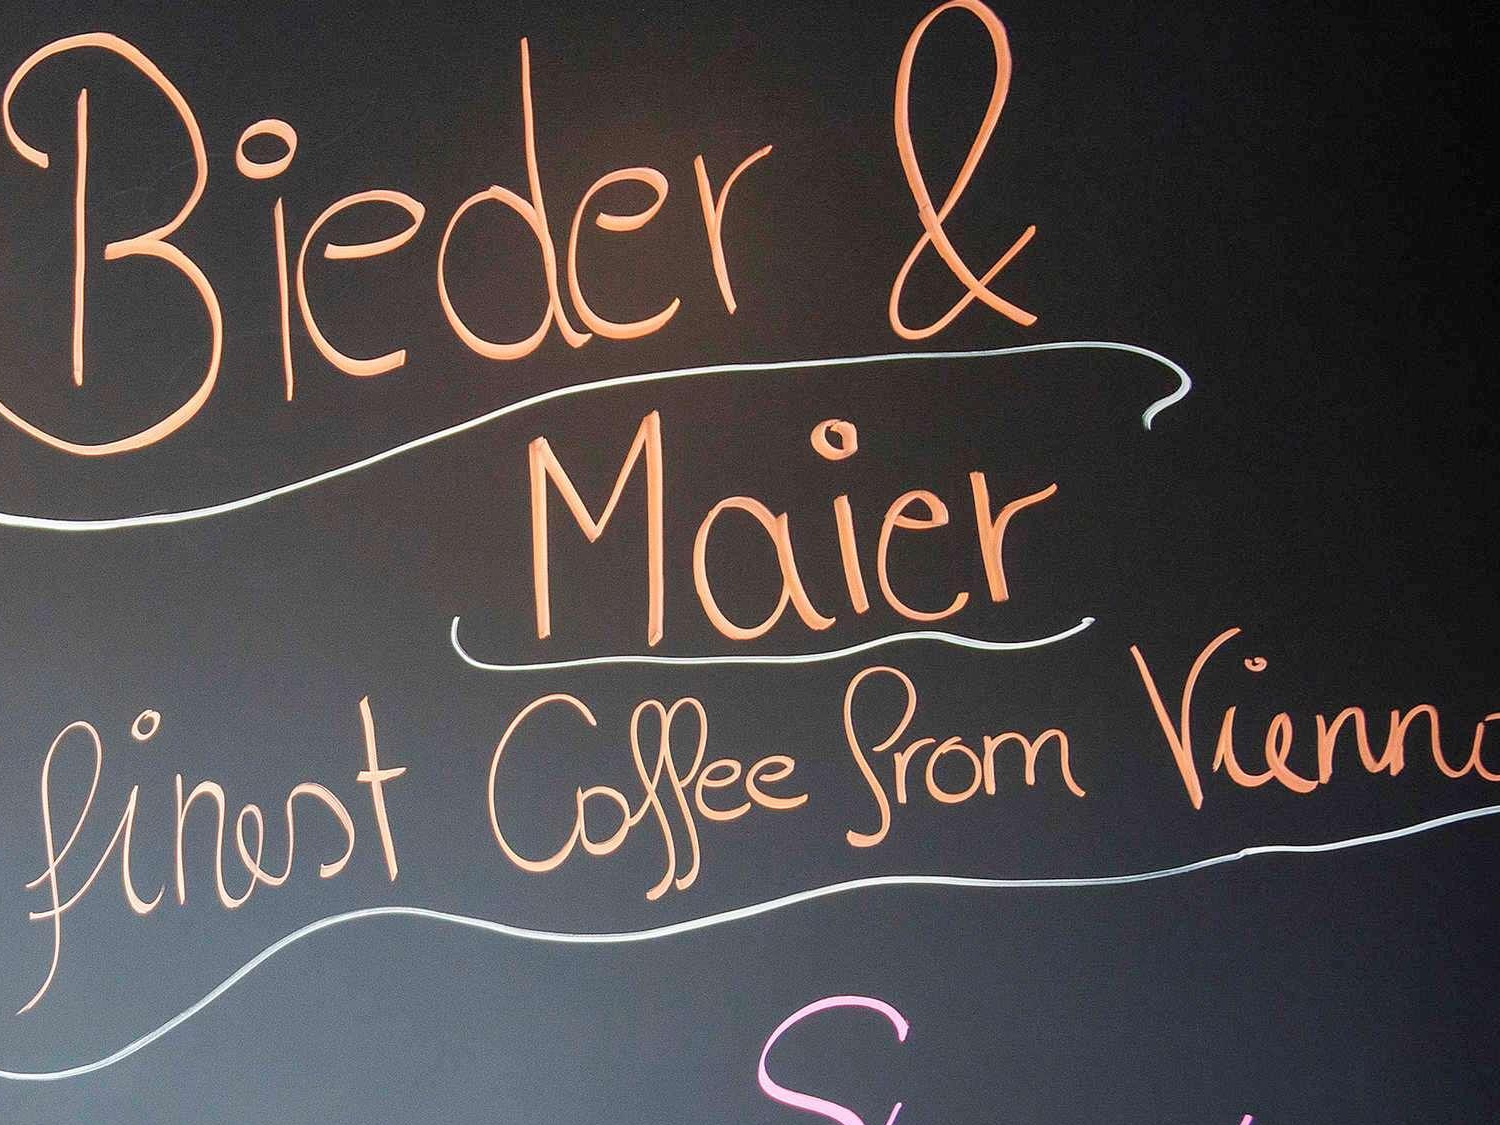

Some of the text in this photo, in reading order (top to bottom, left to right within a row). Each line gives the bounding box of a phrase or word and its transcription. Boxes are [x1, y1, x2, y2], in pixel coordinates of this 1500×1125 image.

[889, 0, 1038, 340] &
[529, 411, 1058, 647] Maier
[15, 695, 408, 1015] finest
[487, 693, 809, 902] Coffee
[843, 666, 1087, 847] from
